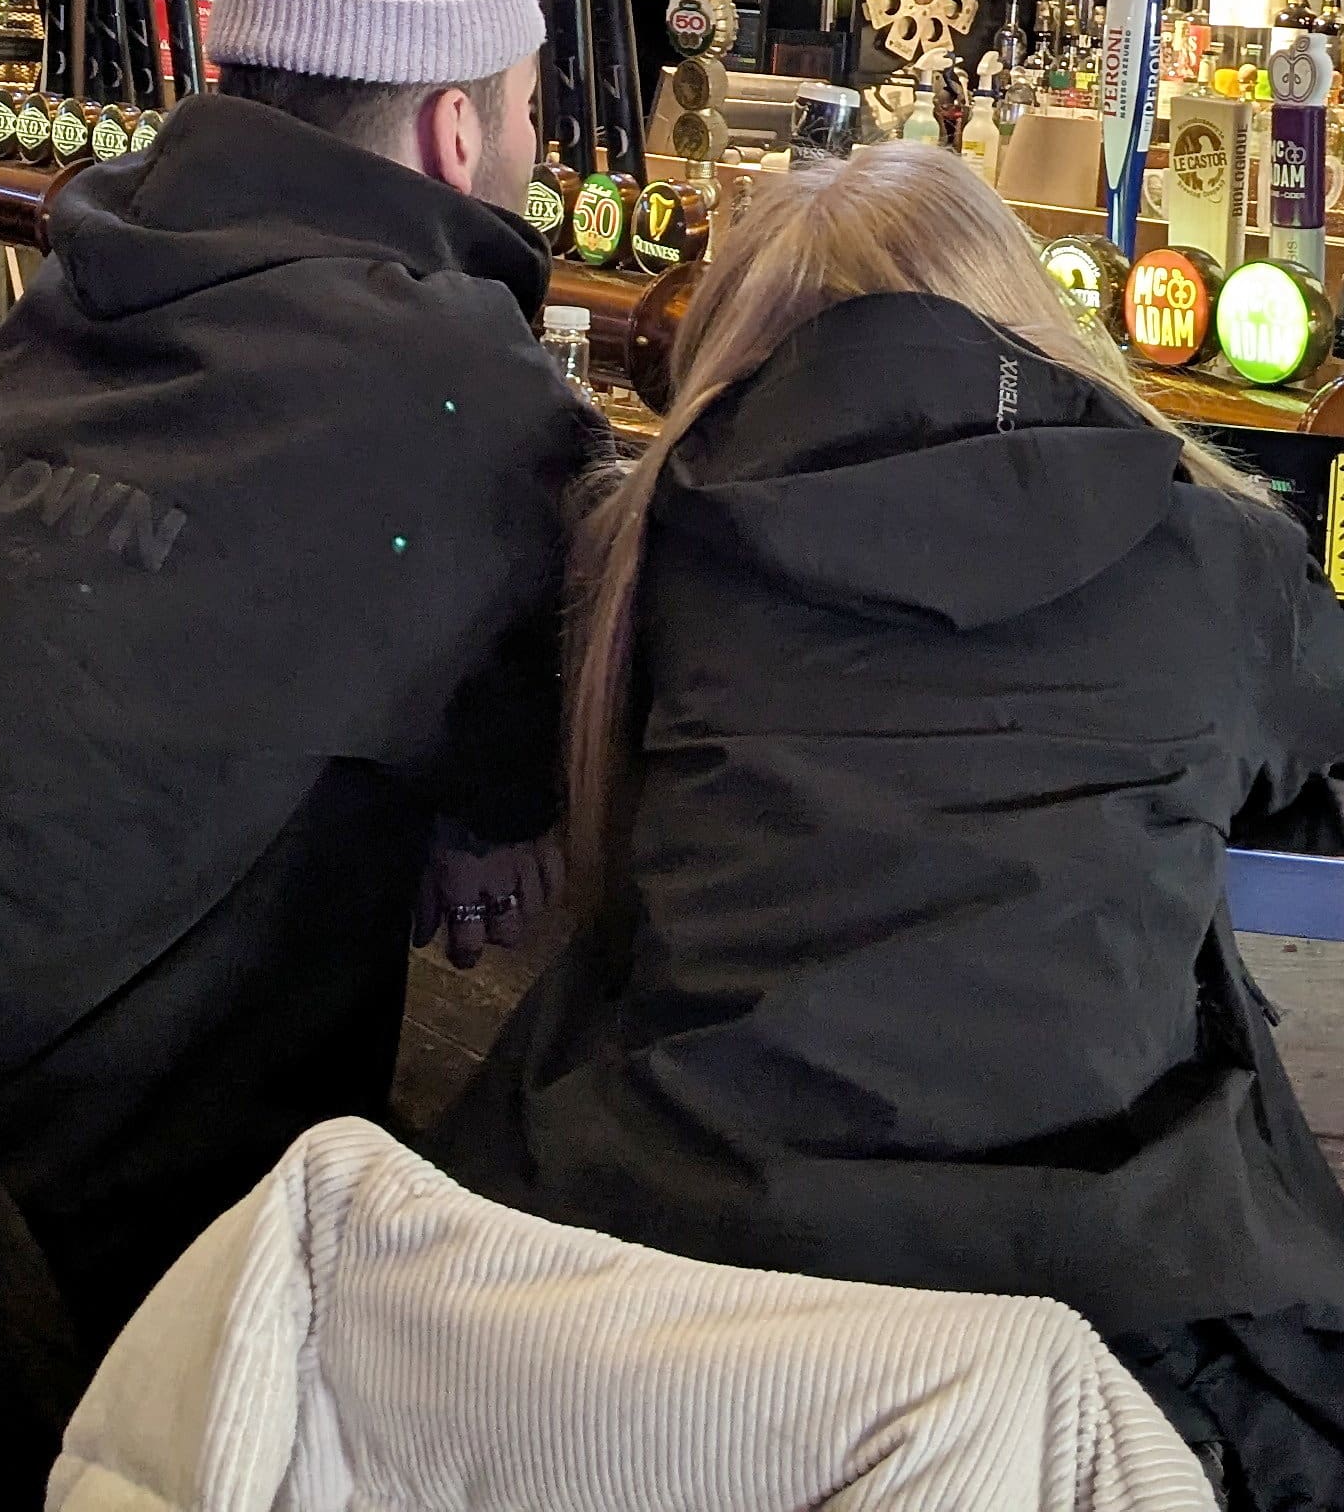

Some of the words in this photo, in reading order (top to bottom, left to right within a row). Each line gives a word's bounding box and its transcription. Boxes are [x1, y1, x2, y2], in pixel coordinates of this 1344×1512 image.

[675, 14, 704, 31] 50
[1104, 27, 1123, 117] PERONI
[1122, 29, 1132, 76] AZZURRO
[1119, 80, 1128, 119] NASTRO
[1173, 158, 1186, 172] LE
[1187, 151, 1228, 170] CASTOR
[1232, 123, 1249, 218] BIOLOGIQUE
[1272, 163, 1306, 188] DAM
[573, 190, 620, 241] 50
[632, 233, 681, 262] GUINNESS
[1135, 304, 1195, 348] ADAM
[997, 354, 1018, 435] C'TERYX
